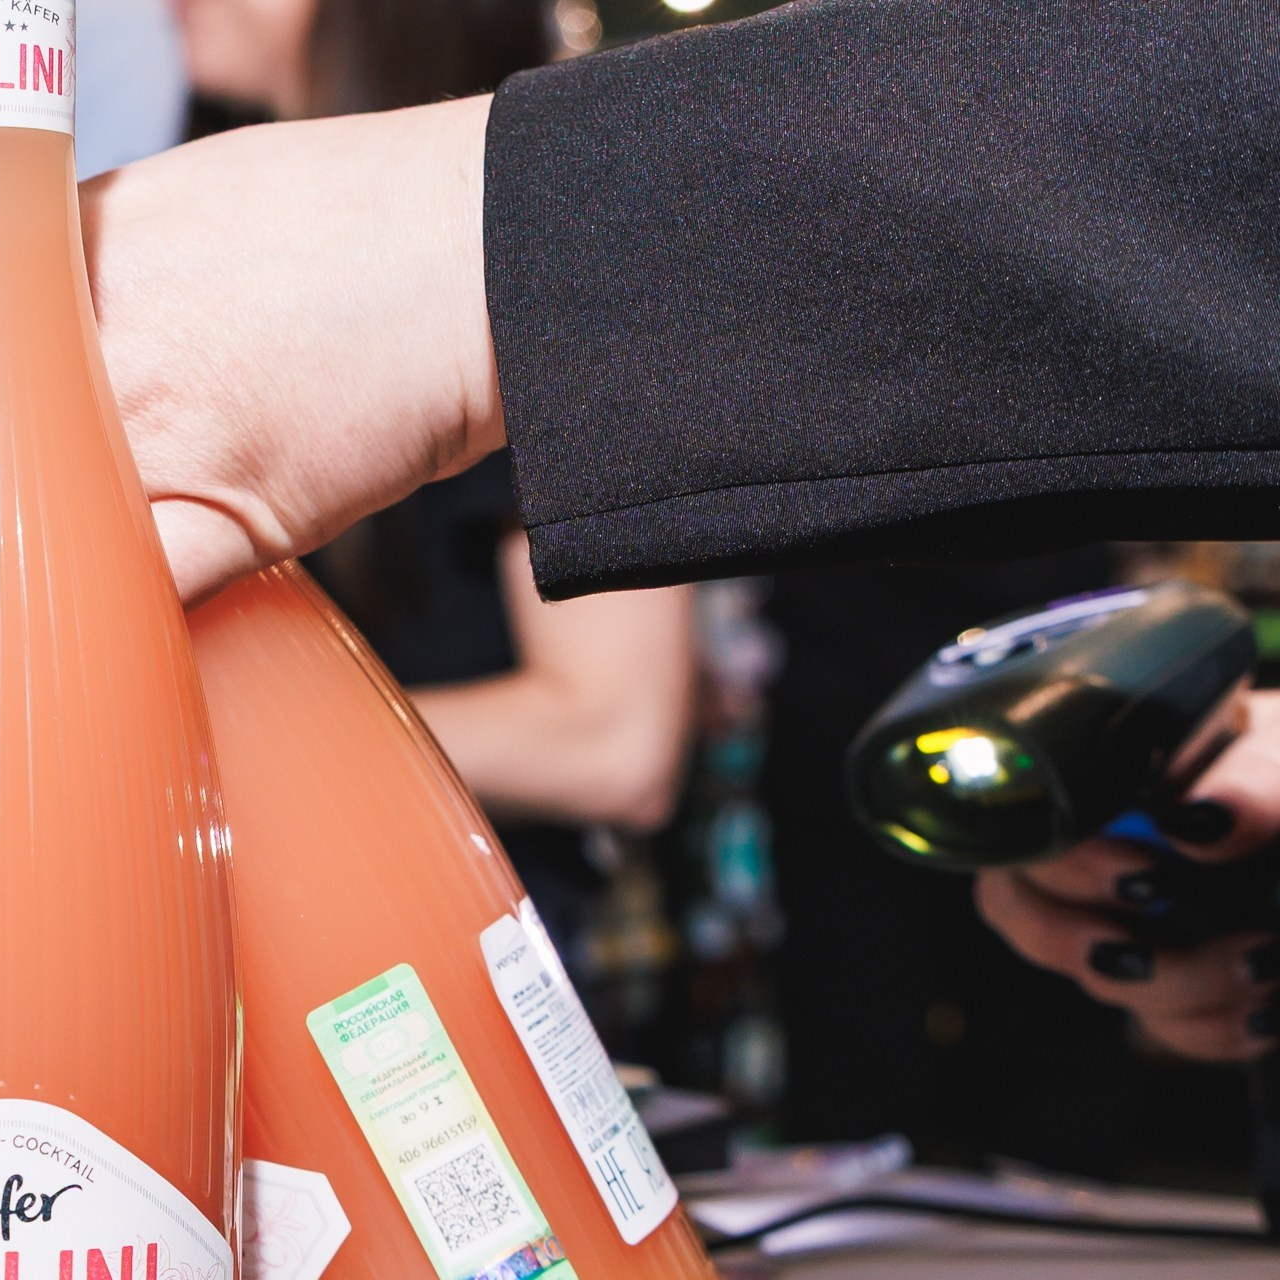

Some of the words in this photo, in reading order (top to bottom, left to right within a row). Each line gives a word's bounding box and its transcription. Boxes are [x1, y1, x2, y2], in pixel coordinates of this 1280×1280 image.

[11, 0, 60, 26] KÄFER
[333, 990, 404, 1033] РОССИЙСКАЯ
[339, 1001, 410, 1043] ФЕДЕРАЦИЯ
[371, 1052, 428, 1085] ФЕДЕРАЛЬНАЯ
[421, 1115, 478, 1152] 96615159
[12, 1135, 95, 1183] COCKTAIL
